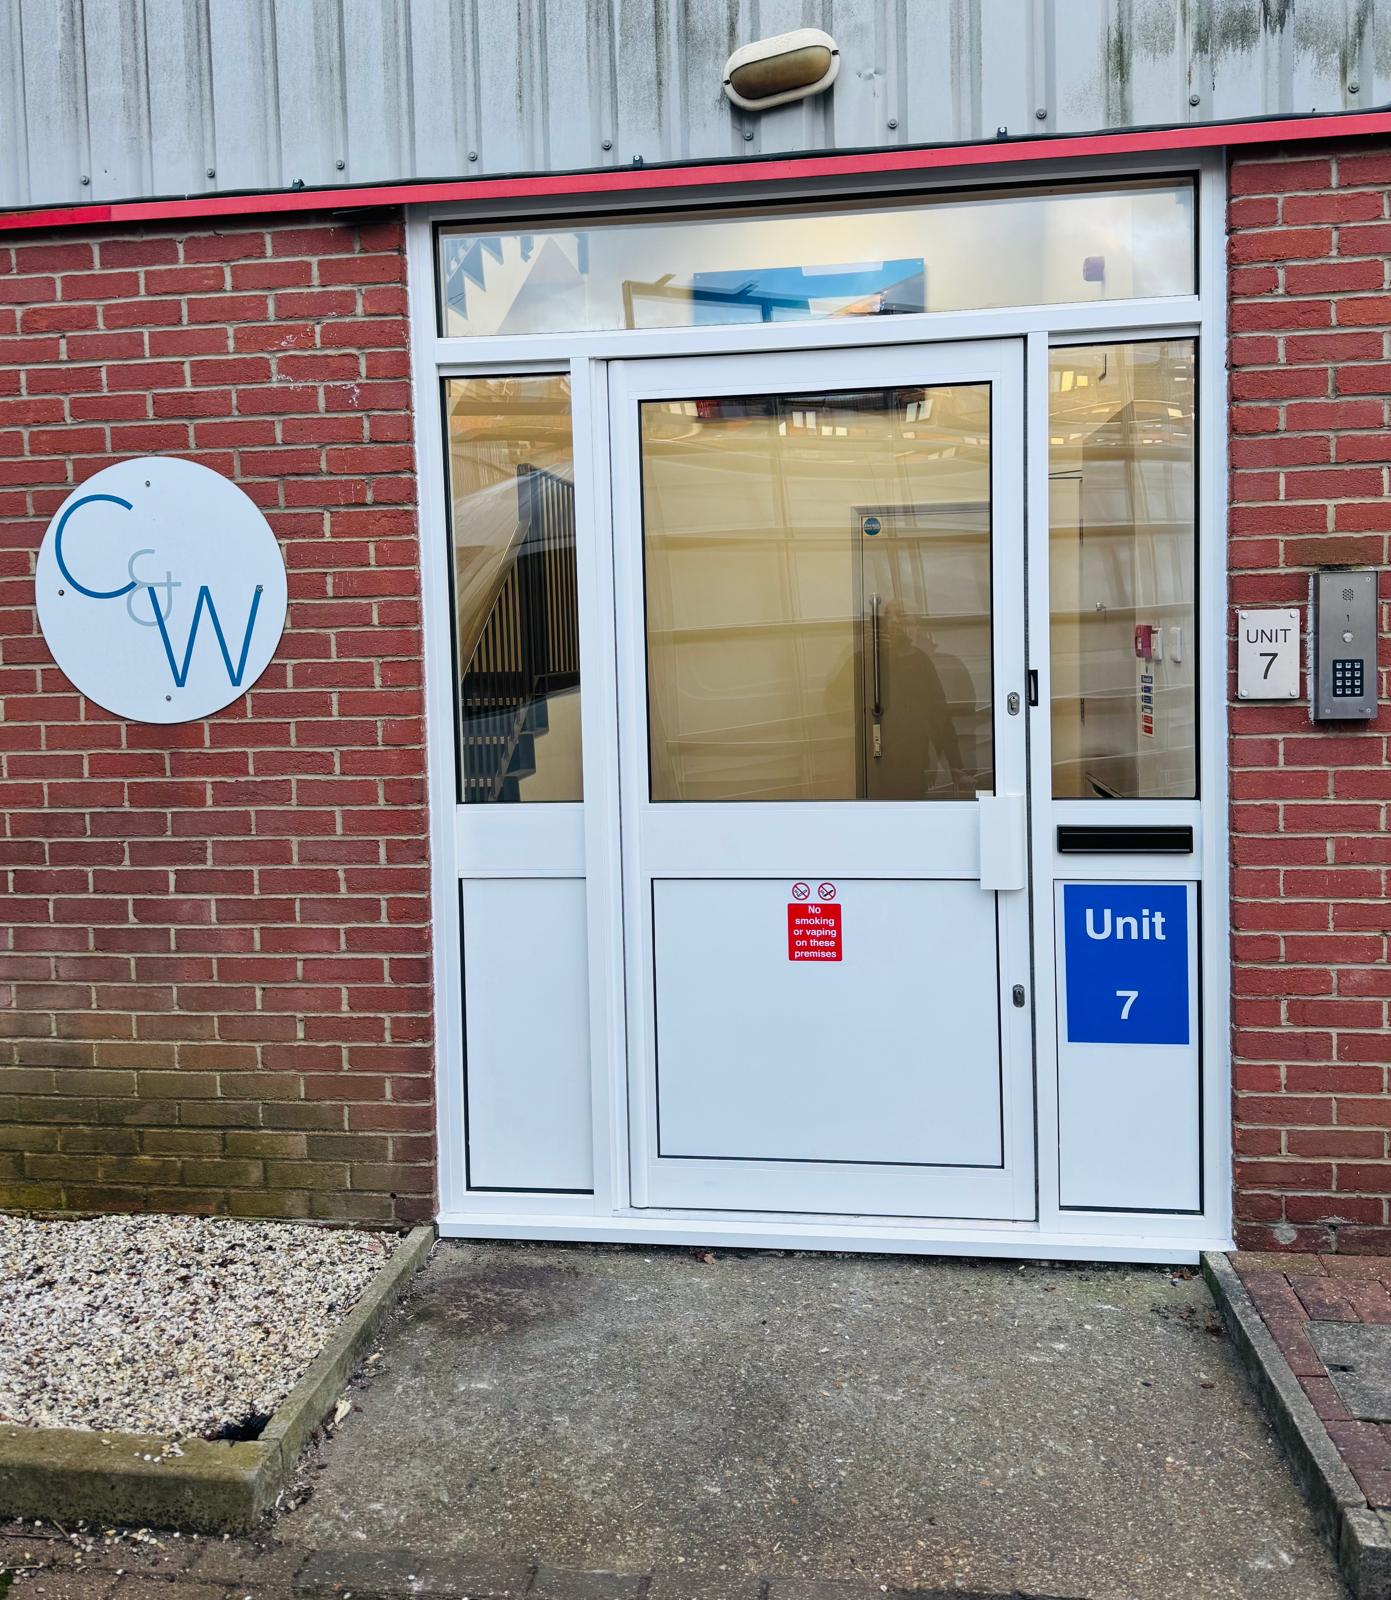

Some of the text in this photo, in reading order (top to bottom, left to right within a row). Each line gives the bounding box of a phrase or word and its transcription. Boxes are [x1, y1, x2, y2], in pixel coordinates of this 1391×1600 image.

[1246, 628, 1292, 644] UNIT
[1259, 652, 1279, 680] 7
[807, 905, 822, 914] No
[795, 916, 835, 927] smoking
[1085, 908, 1166, 940] Unit
[793, 928, 837, 938] or vaping
[795, 938, 836, 947] on these
[794, 949, 837, 959] premises
[1116, 990, 1139, 1020] 7
